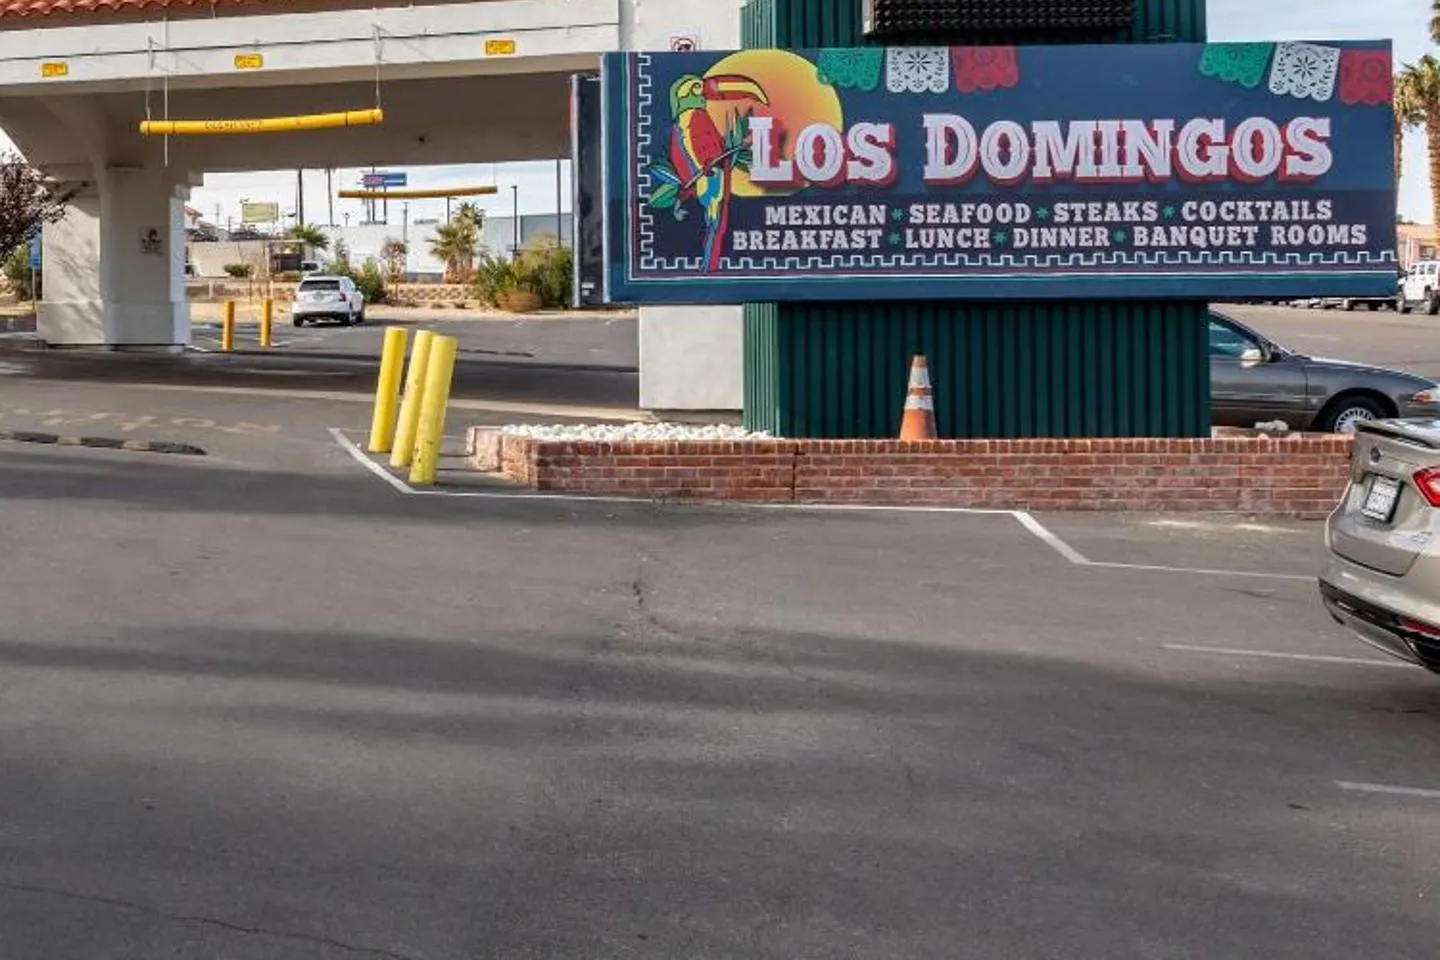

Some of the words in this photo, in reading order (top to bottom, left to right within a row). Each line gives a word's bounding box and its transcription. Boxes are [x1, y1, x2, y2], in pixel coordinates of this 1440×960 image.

[748, 116, 895, 184] LOS
[922, 113, 1334, 183] DOMINGOS
[765, 205, 887, 225] MEXICAN
[909, 203, 1032, 224] SEAFOOD
[1053, 202, 1159, 223] STEAKS
[1181, 200, 1333, 222] COCKTAILS
[732, 230, 883, 251] BREAKFAST
[905, 228, 991, 249] LUNCH
[1013, 227, 1111, 248] DINNER
[1133, 226, 1259, 248] BANQUET
[1270, 224, 1367, 246] ROOMS
